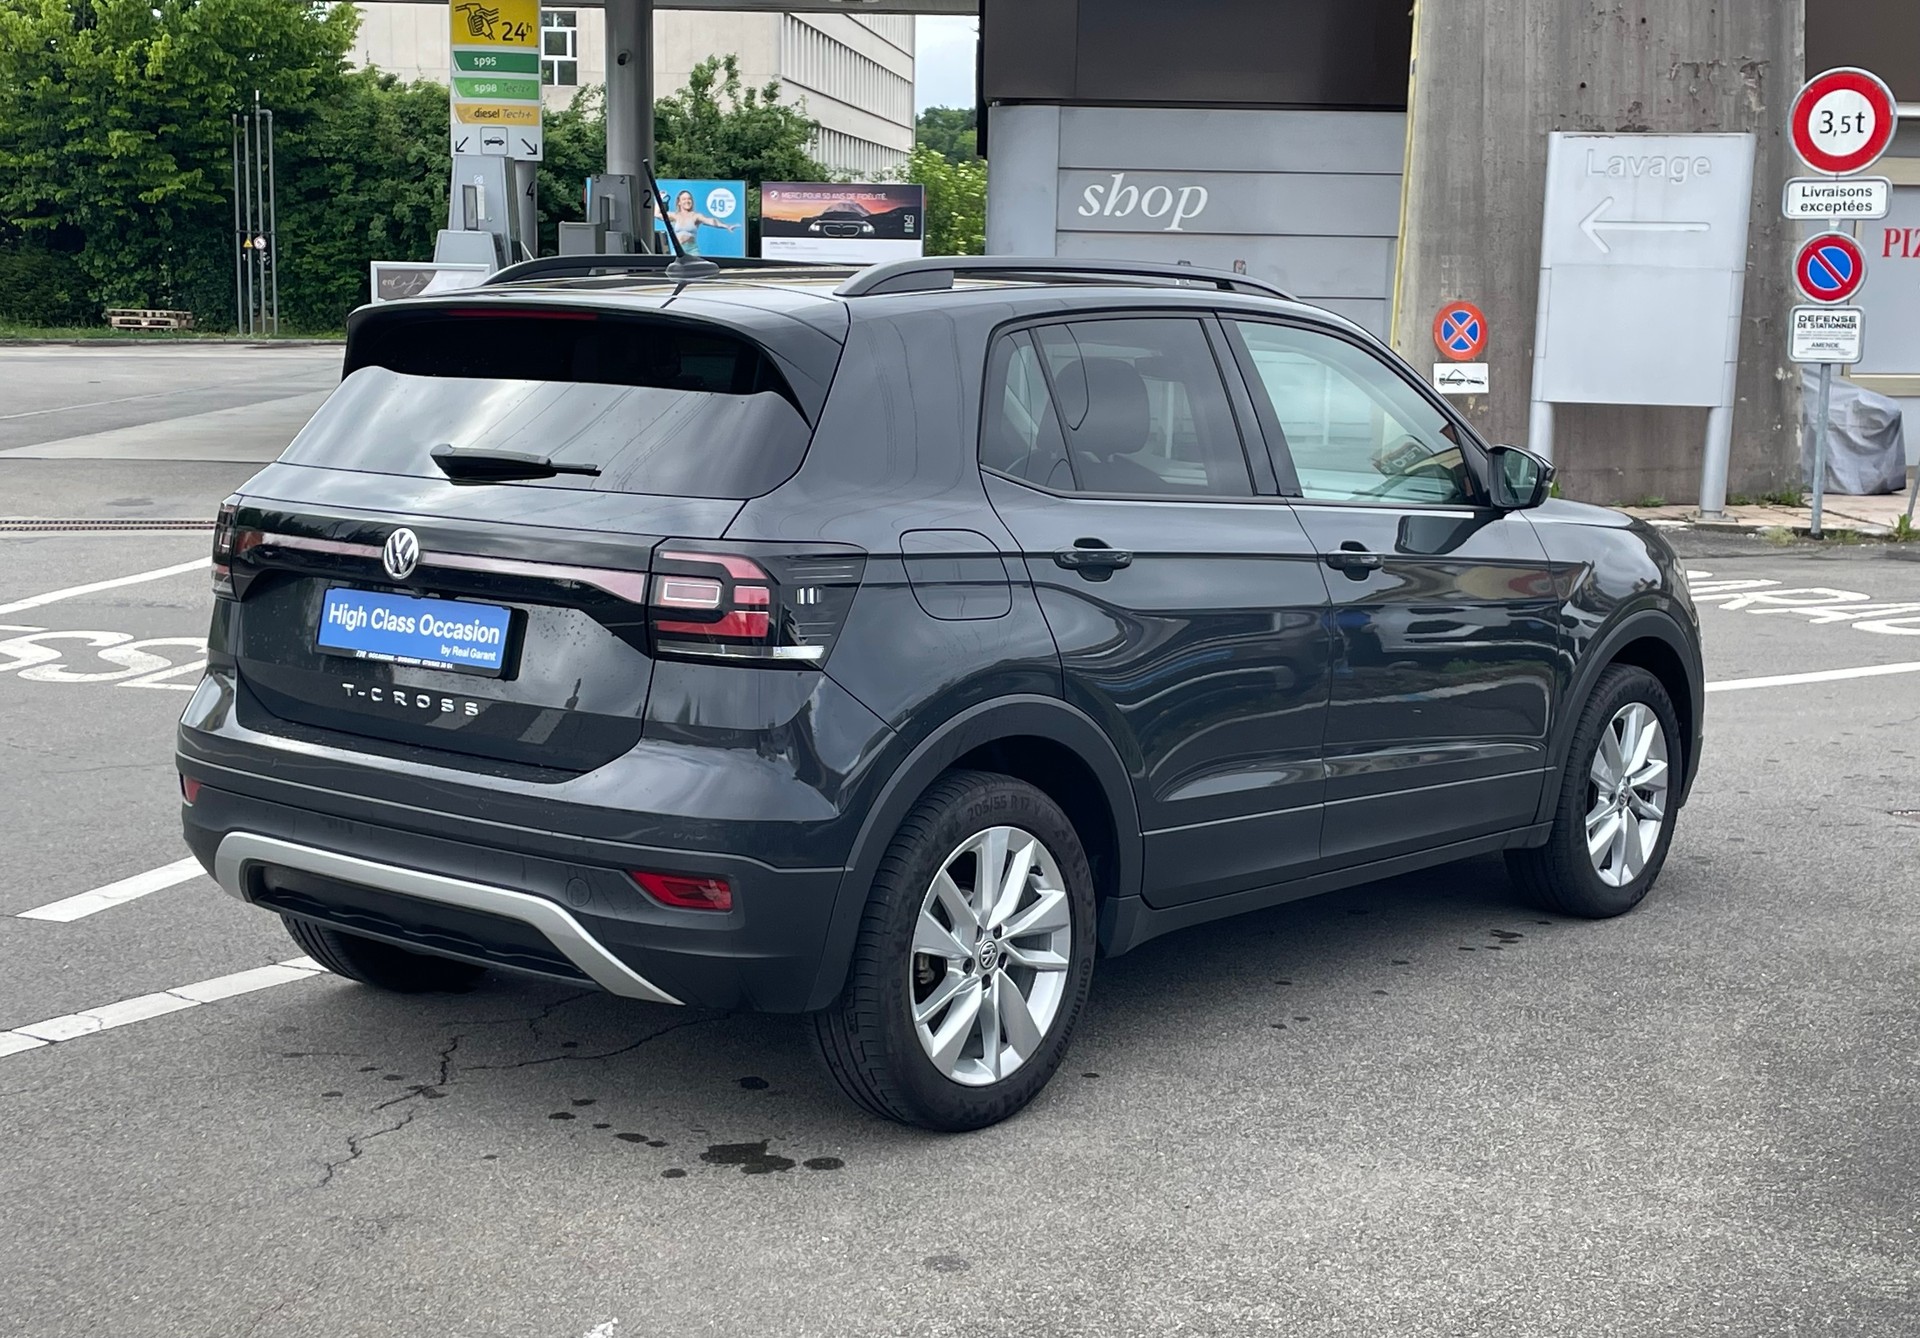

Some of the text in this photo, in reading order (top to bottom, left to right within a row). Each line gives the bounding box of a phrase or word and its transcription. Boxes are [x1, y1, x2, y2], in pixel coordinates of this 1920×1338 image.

[473, 57, 497, 68] sp95
[474, 84, 497, 94] sp98
[474, 107, 532, 119] diesel Tech+
[1586, 148, 1712, 184] Lavage
[525, 180, 535, 201] 4
[803, 192, 821, 200] POUR
[822, 192, 831, 200] 50
[832, 192, 845, 200] ANS
[847, 192, 856, 200] DE
[1802, 185, 1873, 198] Livraisons
[643, 189, 652, 209] 2
[1078, 172, 1208, 231] shop
[1800, 201, 1873, 214] exceptées
[1798, 315, 1857, 323] DEFENSE
[328, 603, 500, 644] High Class Occasion
[441, 644, 497, 661] by Real Garant
[342, 683, 479, 716] T-CROSS
